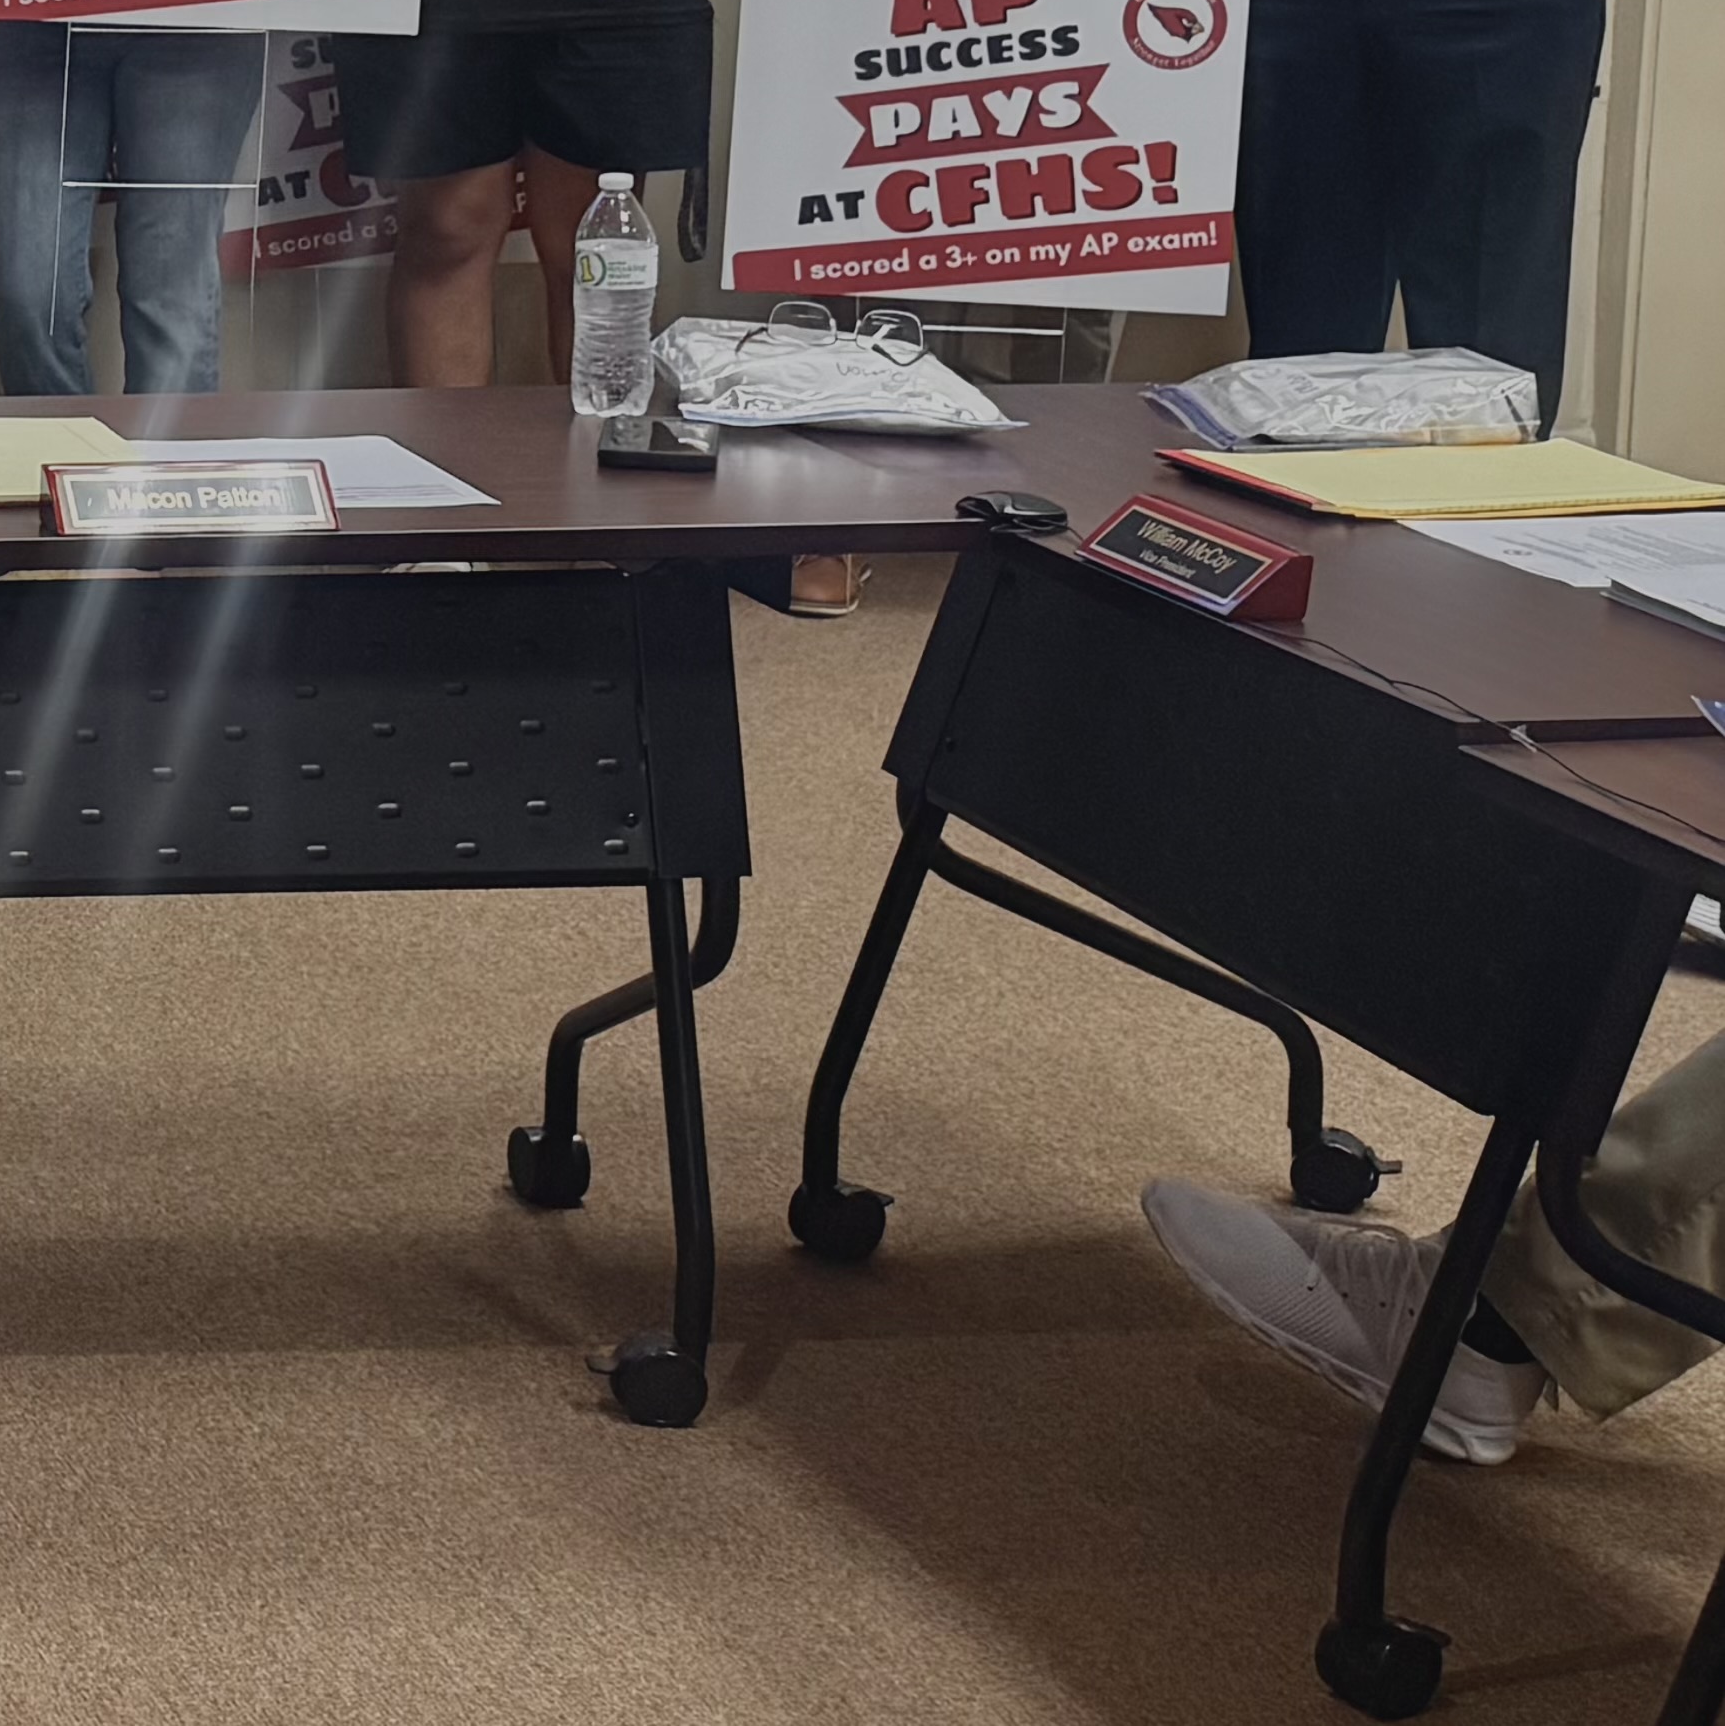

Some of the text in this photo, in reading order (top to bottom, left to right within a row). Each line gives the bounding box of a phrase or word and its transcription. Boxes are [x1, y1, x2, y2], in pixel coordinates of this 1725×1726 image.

[853, 25, 1081, 81] SUCCESS
[869, 80, 1084, 149] PAYS
[258, 169, 311, 207] AT
[797, 140, 1179, 234] AT CFHS!
[268, 220, 378, 256] scored a
[793, 221, 1218, 281] I scored a 3+ on my AP exam!
[105, 485, 283, 510] Macon Patton
[1136, 519, 1238, 575] William McCoy
